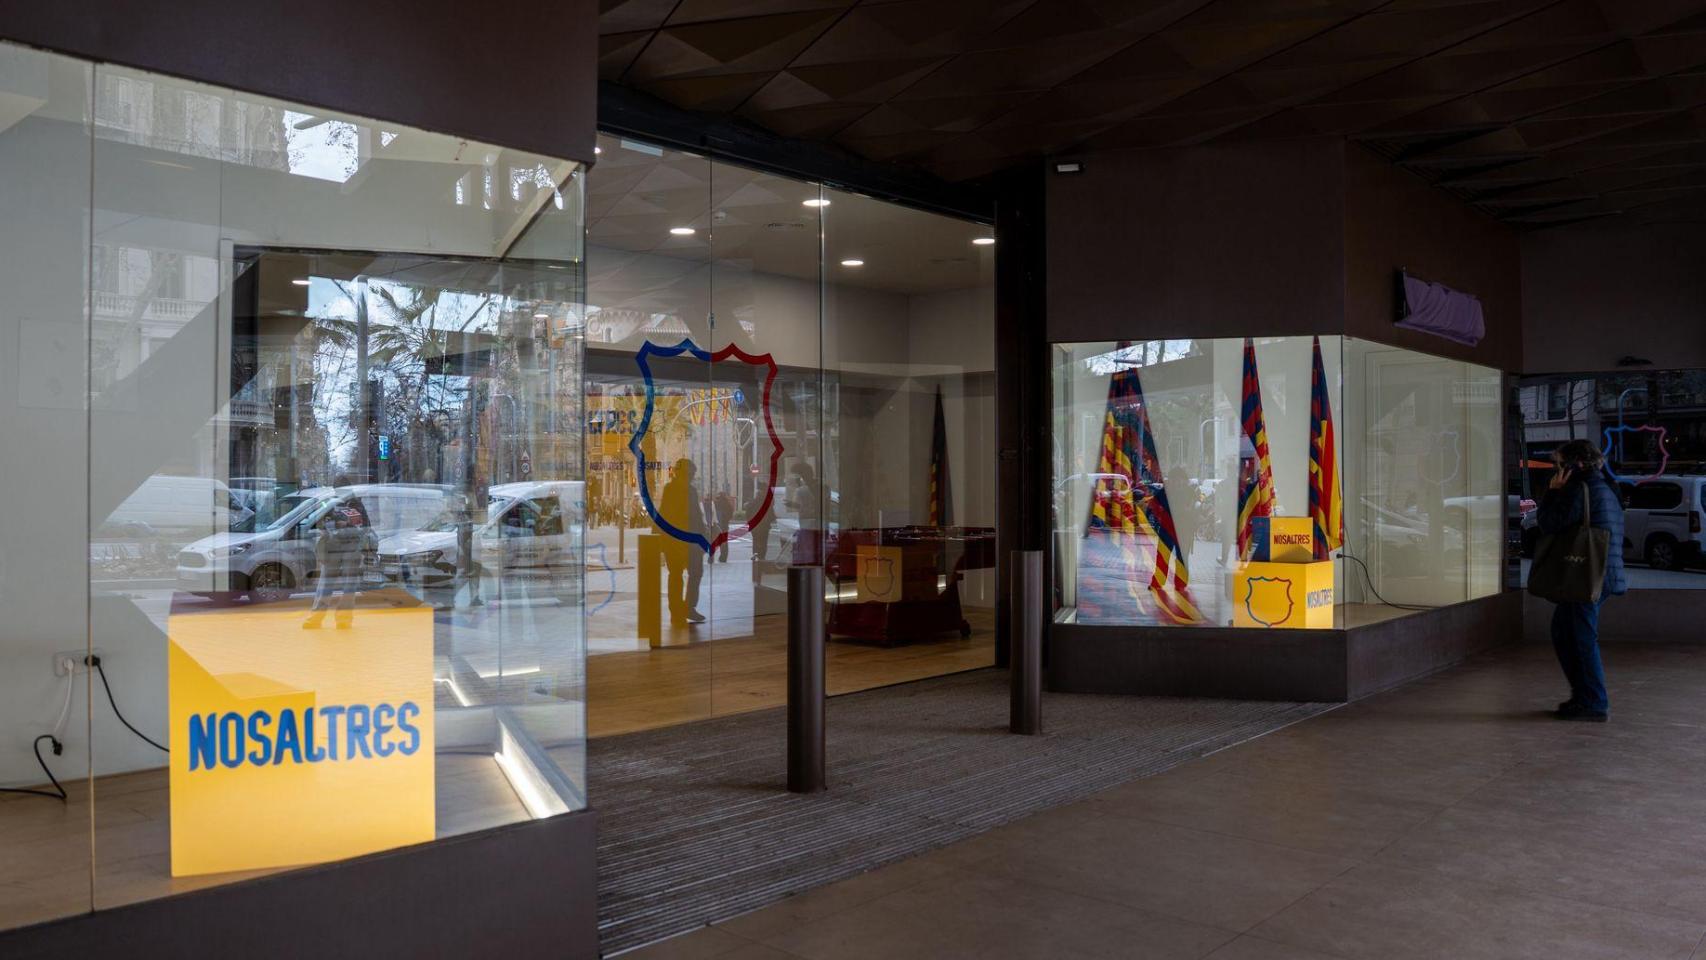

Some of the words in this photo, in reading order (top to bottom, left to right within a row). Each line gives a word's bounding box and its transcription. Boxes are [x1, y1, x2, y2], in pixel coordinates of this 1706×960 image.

[1273, 534, 1310, 545] NOSALTRES
[1307, 588, 1333, 609] NOSALTRES
[188, 701, 420, 772] NOSALTRES
